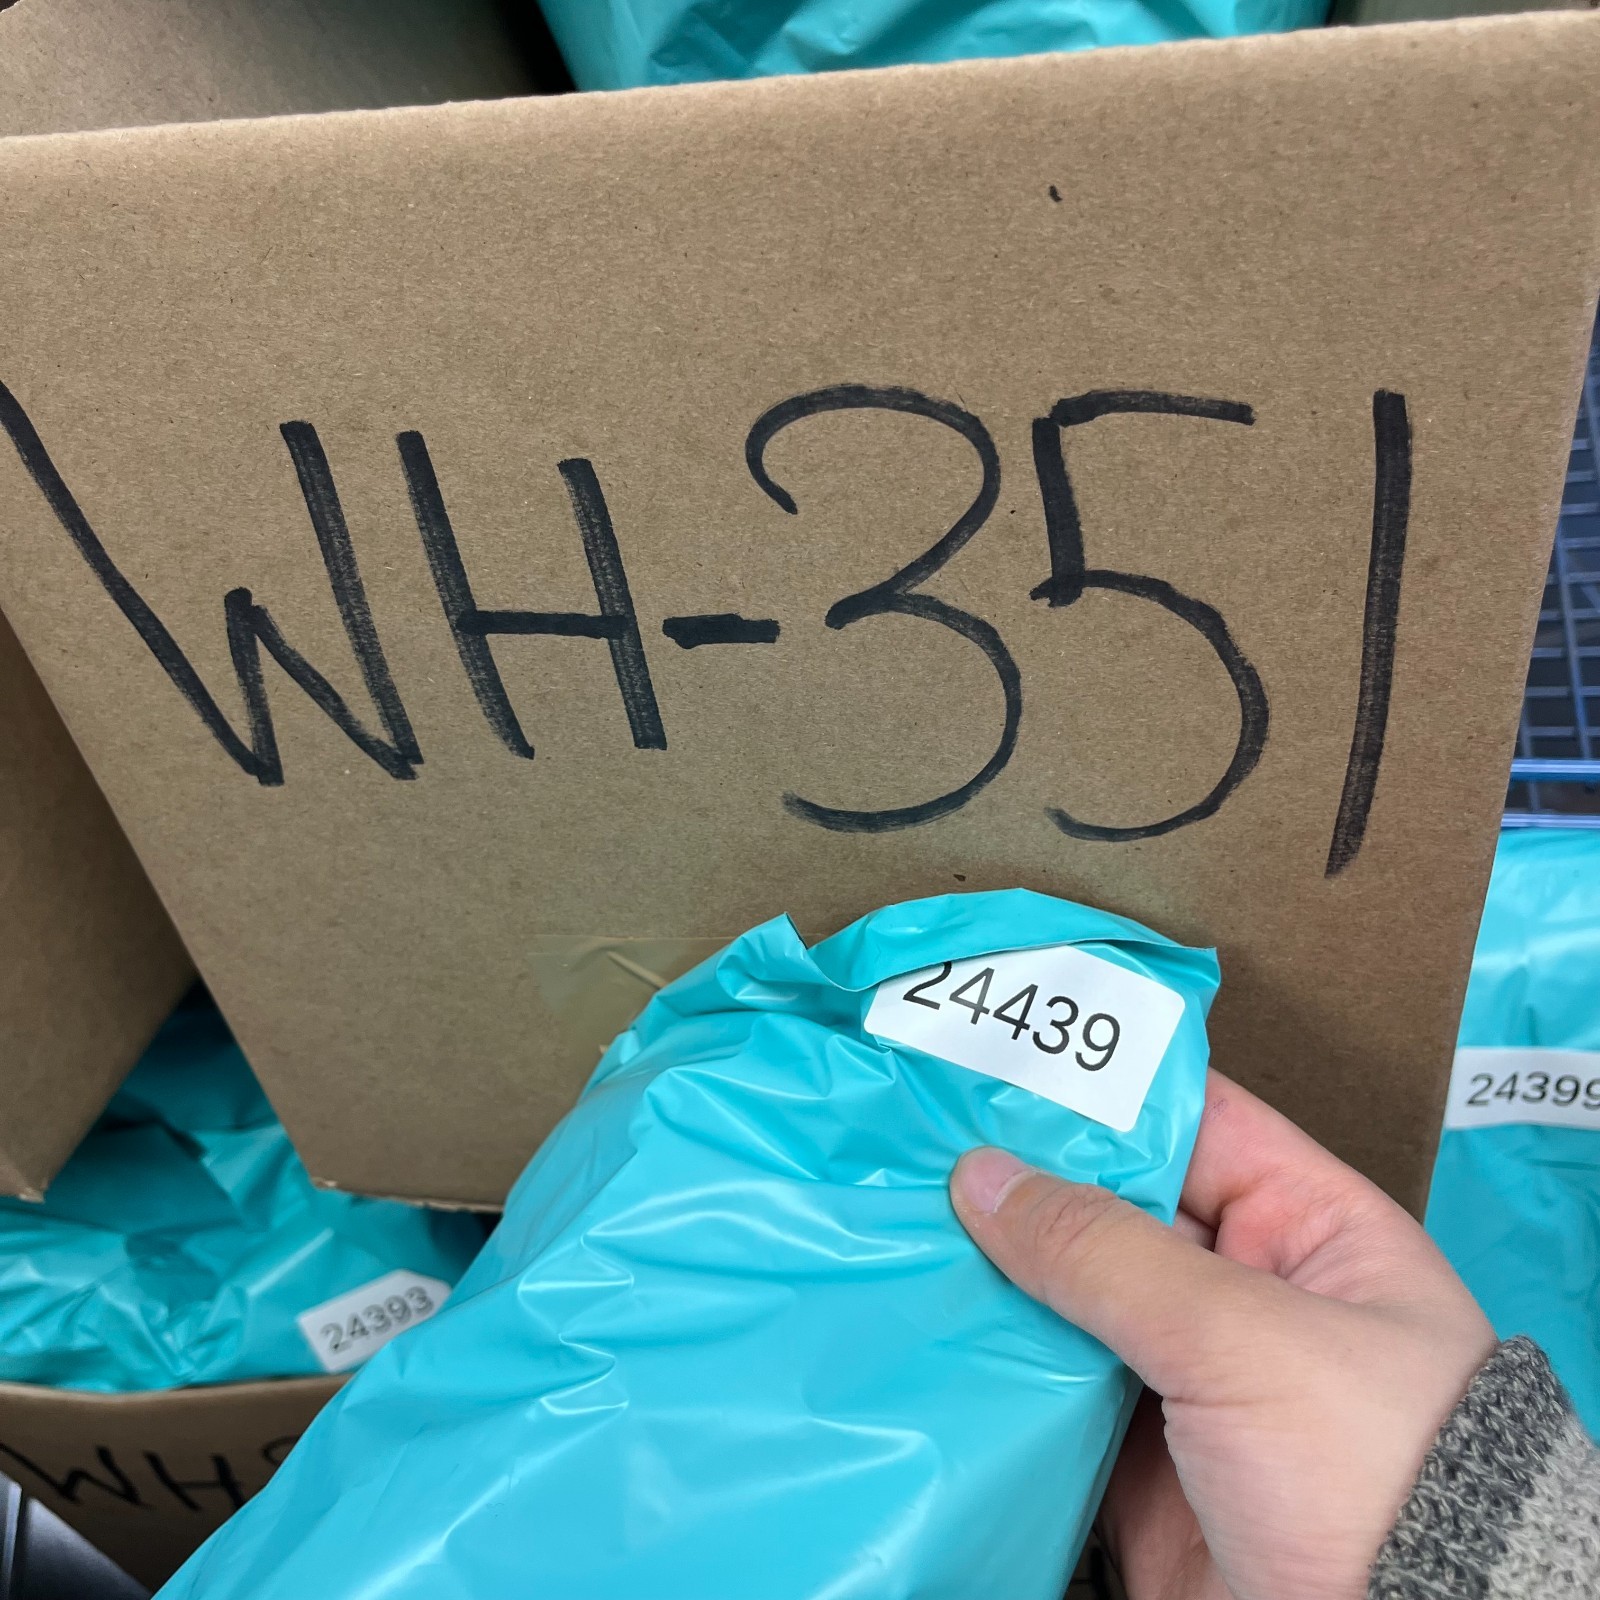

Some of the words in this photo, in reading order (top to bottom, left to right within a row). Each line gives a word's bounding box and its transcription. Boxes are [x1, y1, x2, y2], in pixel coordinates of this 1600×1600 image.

[0, 379, 1413, 877] WH-351
[903, 961, 1121, 1071] 24439
[319, 1286, 435, 1354] 24393
